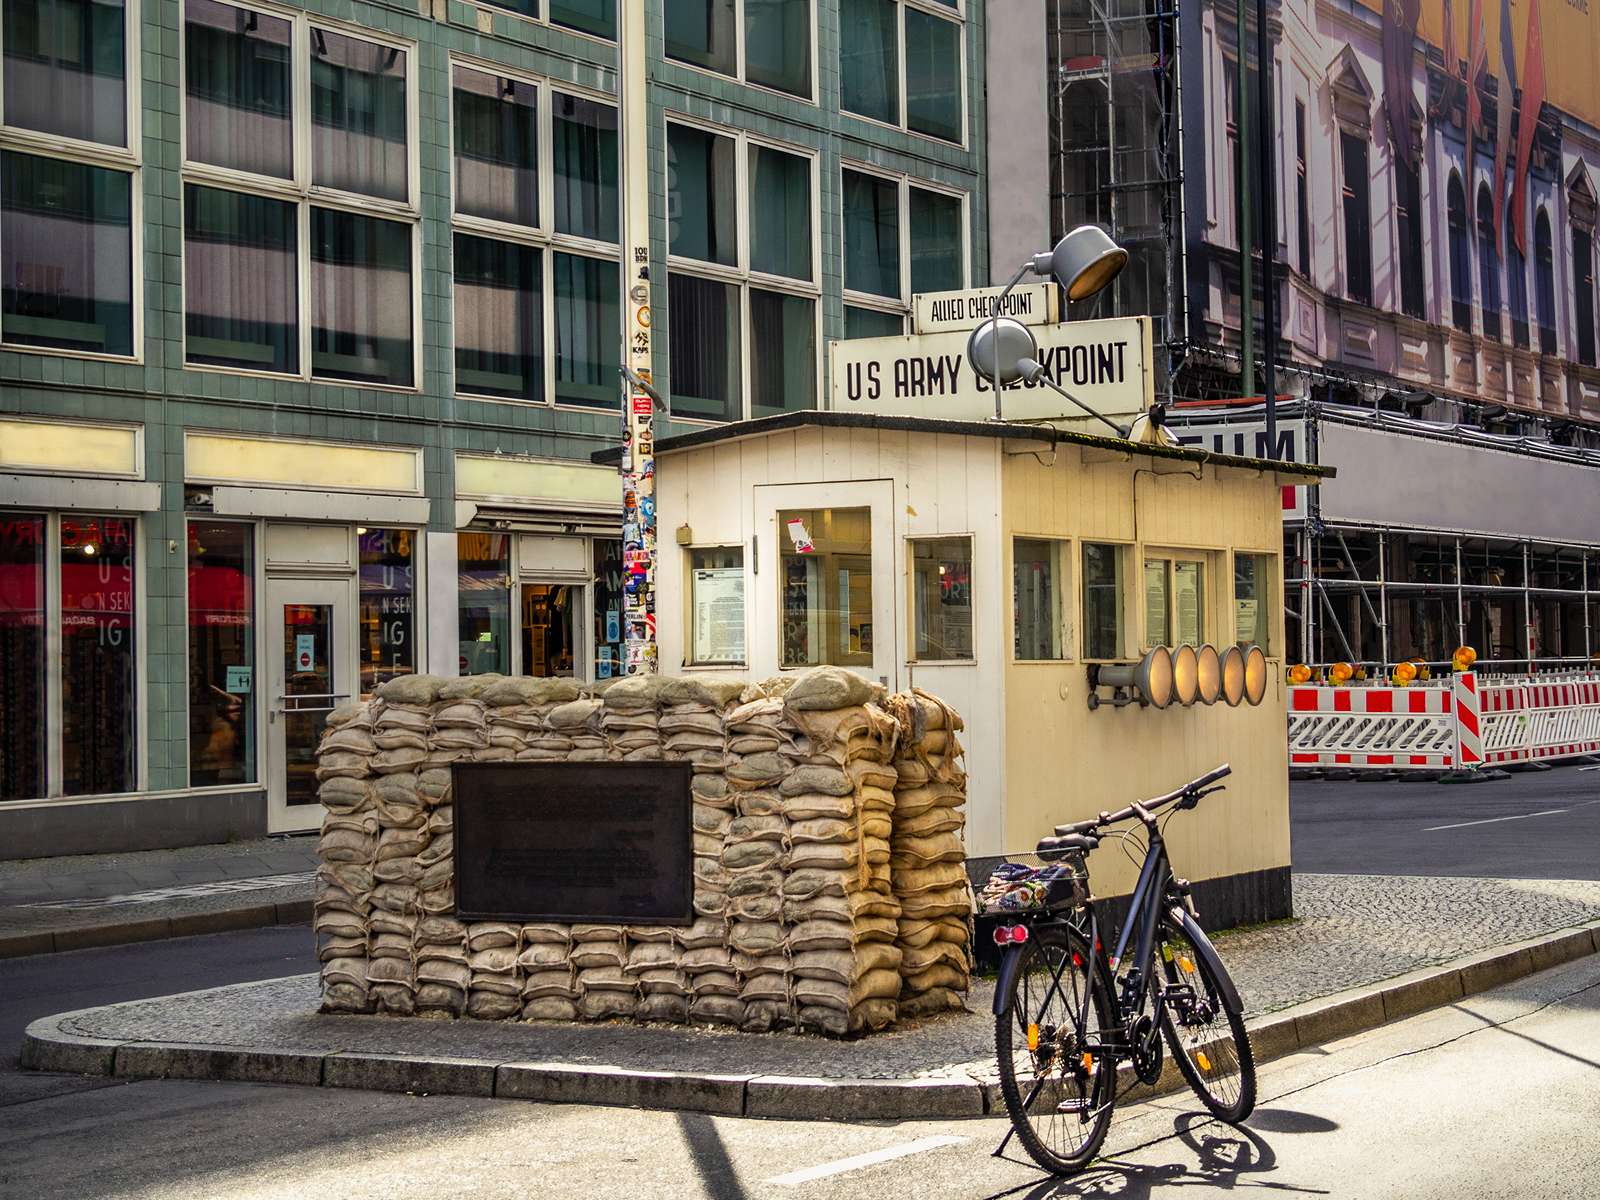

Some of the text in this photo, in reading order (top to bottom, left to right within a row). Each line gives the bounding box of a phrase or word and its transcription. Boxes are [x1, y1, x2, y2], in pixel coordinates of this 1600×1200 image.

[931, 292, 1033, 323] ALLIED CHECKPOINT
[894, 354, 962, 398] ARMY
[975, 341, 1128, 392] KPOINT
